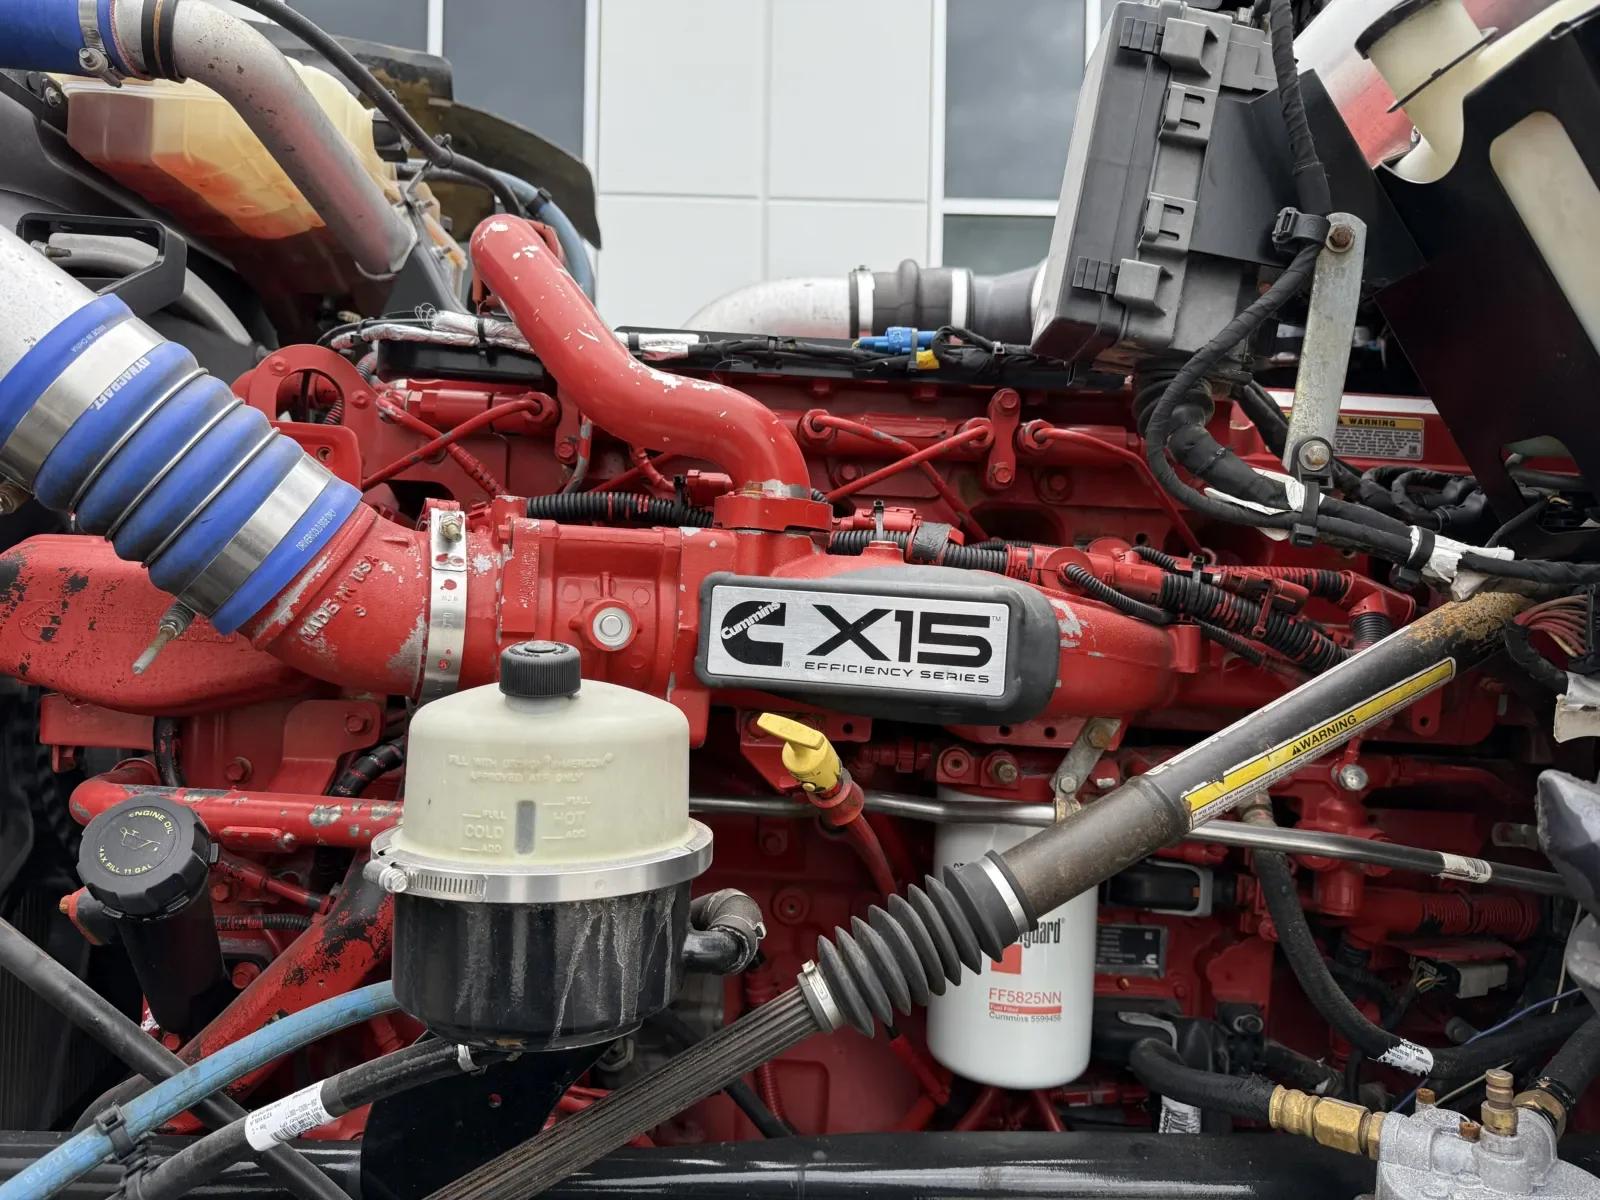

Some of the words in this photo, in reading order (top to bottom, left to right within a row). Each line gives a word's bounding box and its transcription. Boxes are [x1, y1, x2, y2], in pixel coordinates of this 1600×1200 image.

[94, 356, 151, 410] DYNACRAFT
[1349, 418, 1396, 427] WARNING
[299, 597, 340, 642] MADE
[349, 554, 380, 582] USA
[720, 601, 781, 640] Cummins
[806, 603, 993, 668] X15
[804, 661, 914, 678] EFFICIENCY
[920, 670, 990, 684] SERIES
[1300, 714, 1357, 750] WARNING
[1223, 793, 1233, 801] the
[128, 810, 166, 822] ENGINE
[164, 821, 174, 835] OIL
[464, 824, 504, 840] COLD
[106, 862, 120, 873] FILL
[124, 868, 132, 876] 11
[134, 863, 152, 874] GAL
[1019, 918, 1061, 949] guard
[988, 986, 1062, 1005] FF5825NN
[988, 1011, 1030, 1023] Cummins
